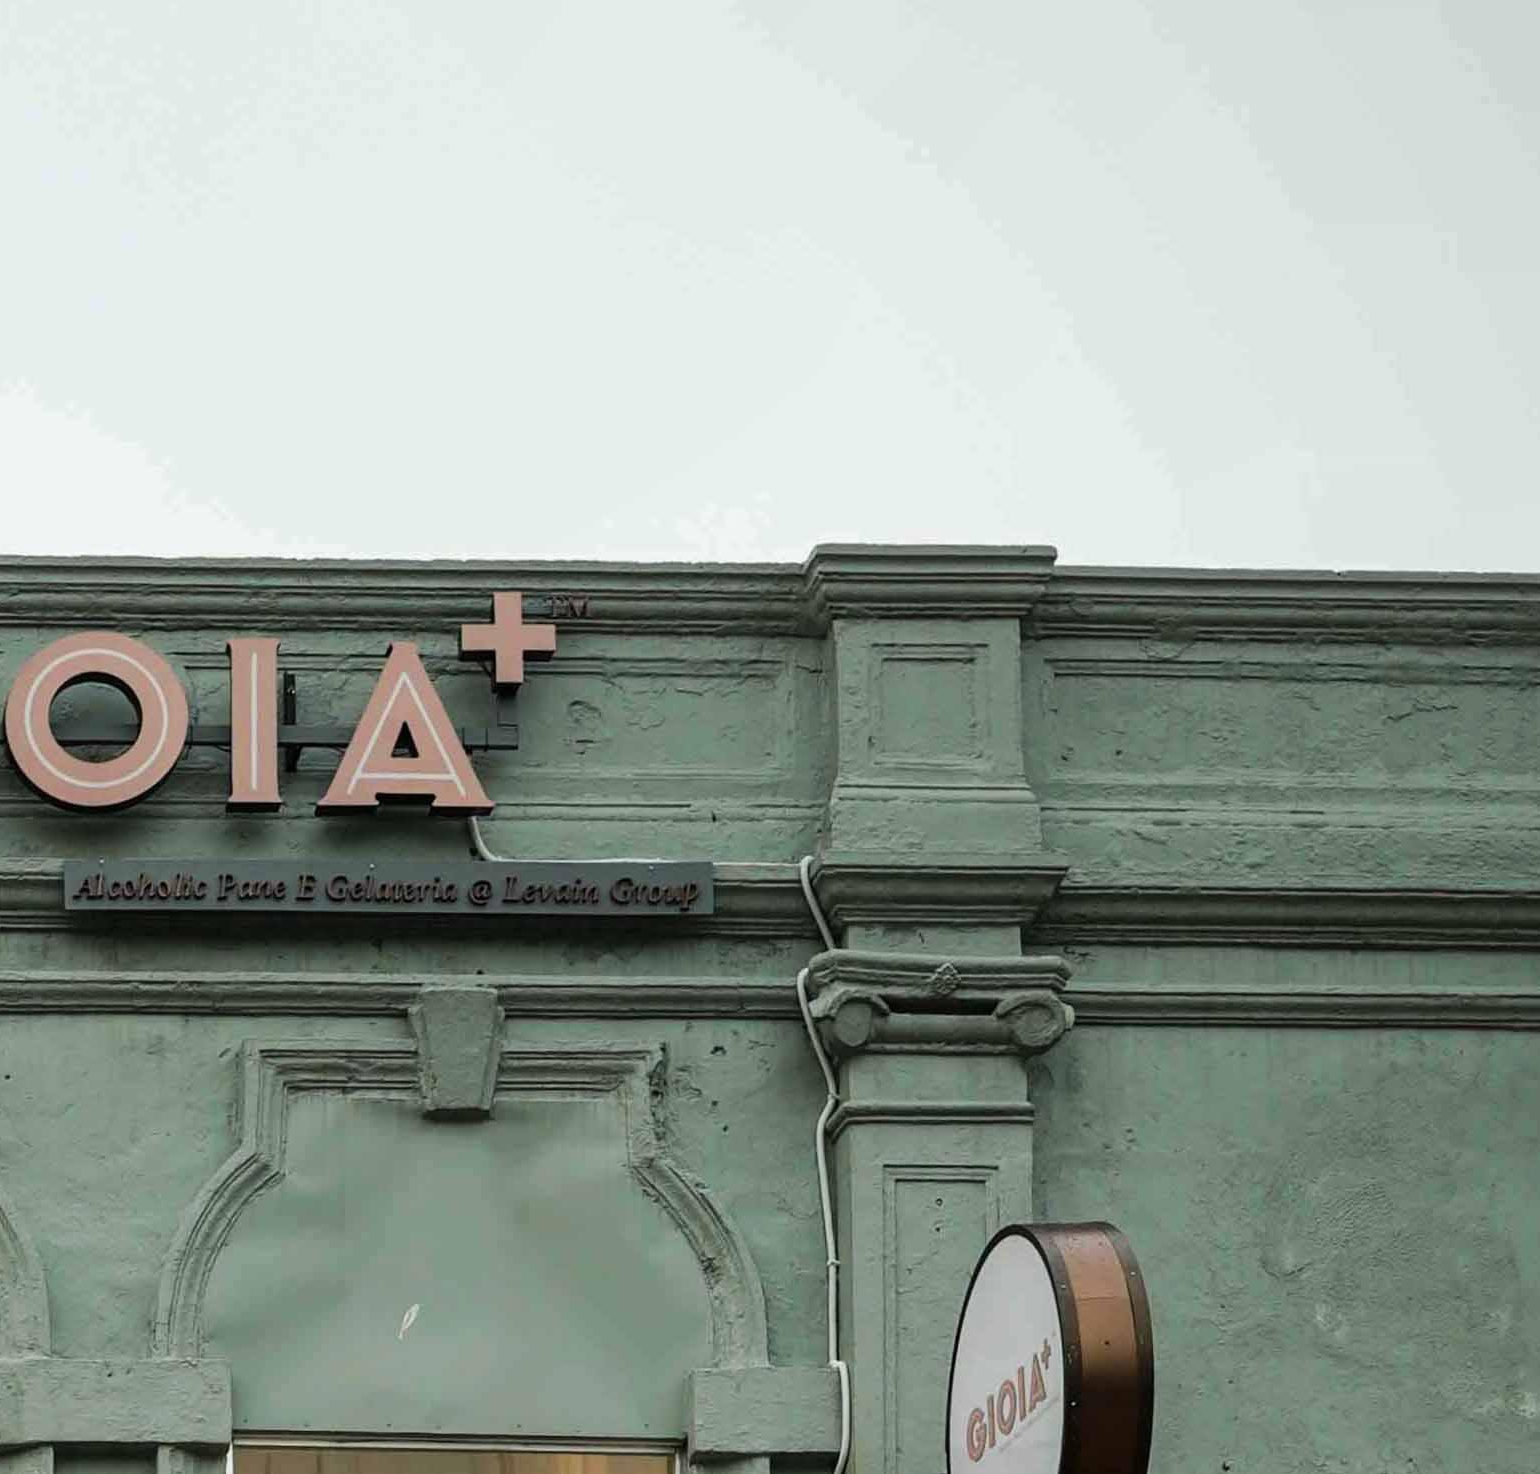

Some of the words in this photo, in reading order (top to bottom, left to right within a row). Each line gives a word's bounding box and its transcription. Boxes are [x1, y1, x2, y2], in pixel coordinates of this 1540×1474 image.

[73, 871, 208, 902] Alcoholic
[217, 873, 287, 901] Pane
[296, 873, 317, 902] E
[324, 874, 459, 905] Gelateria
[470, 880, 493, 907] @
[610, 877, 701, 912] Group
